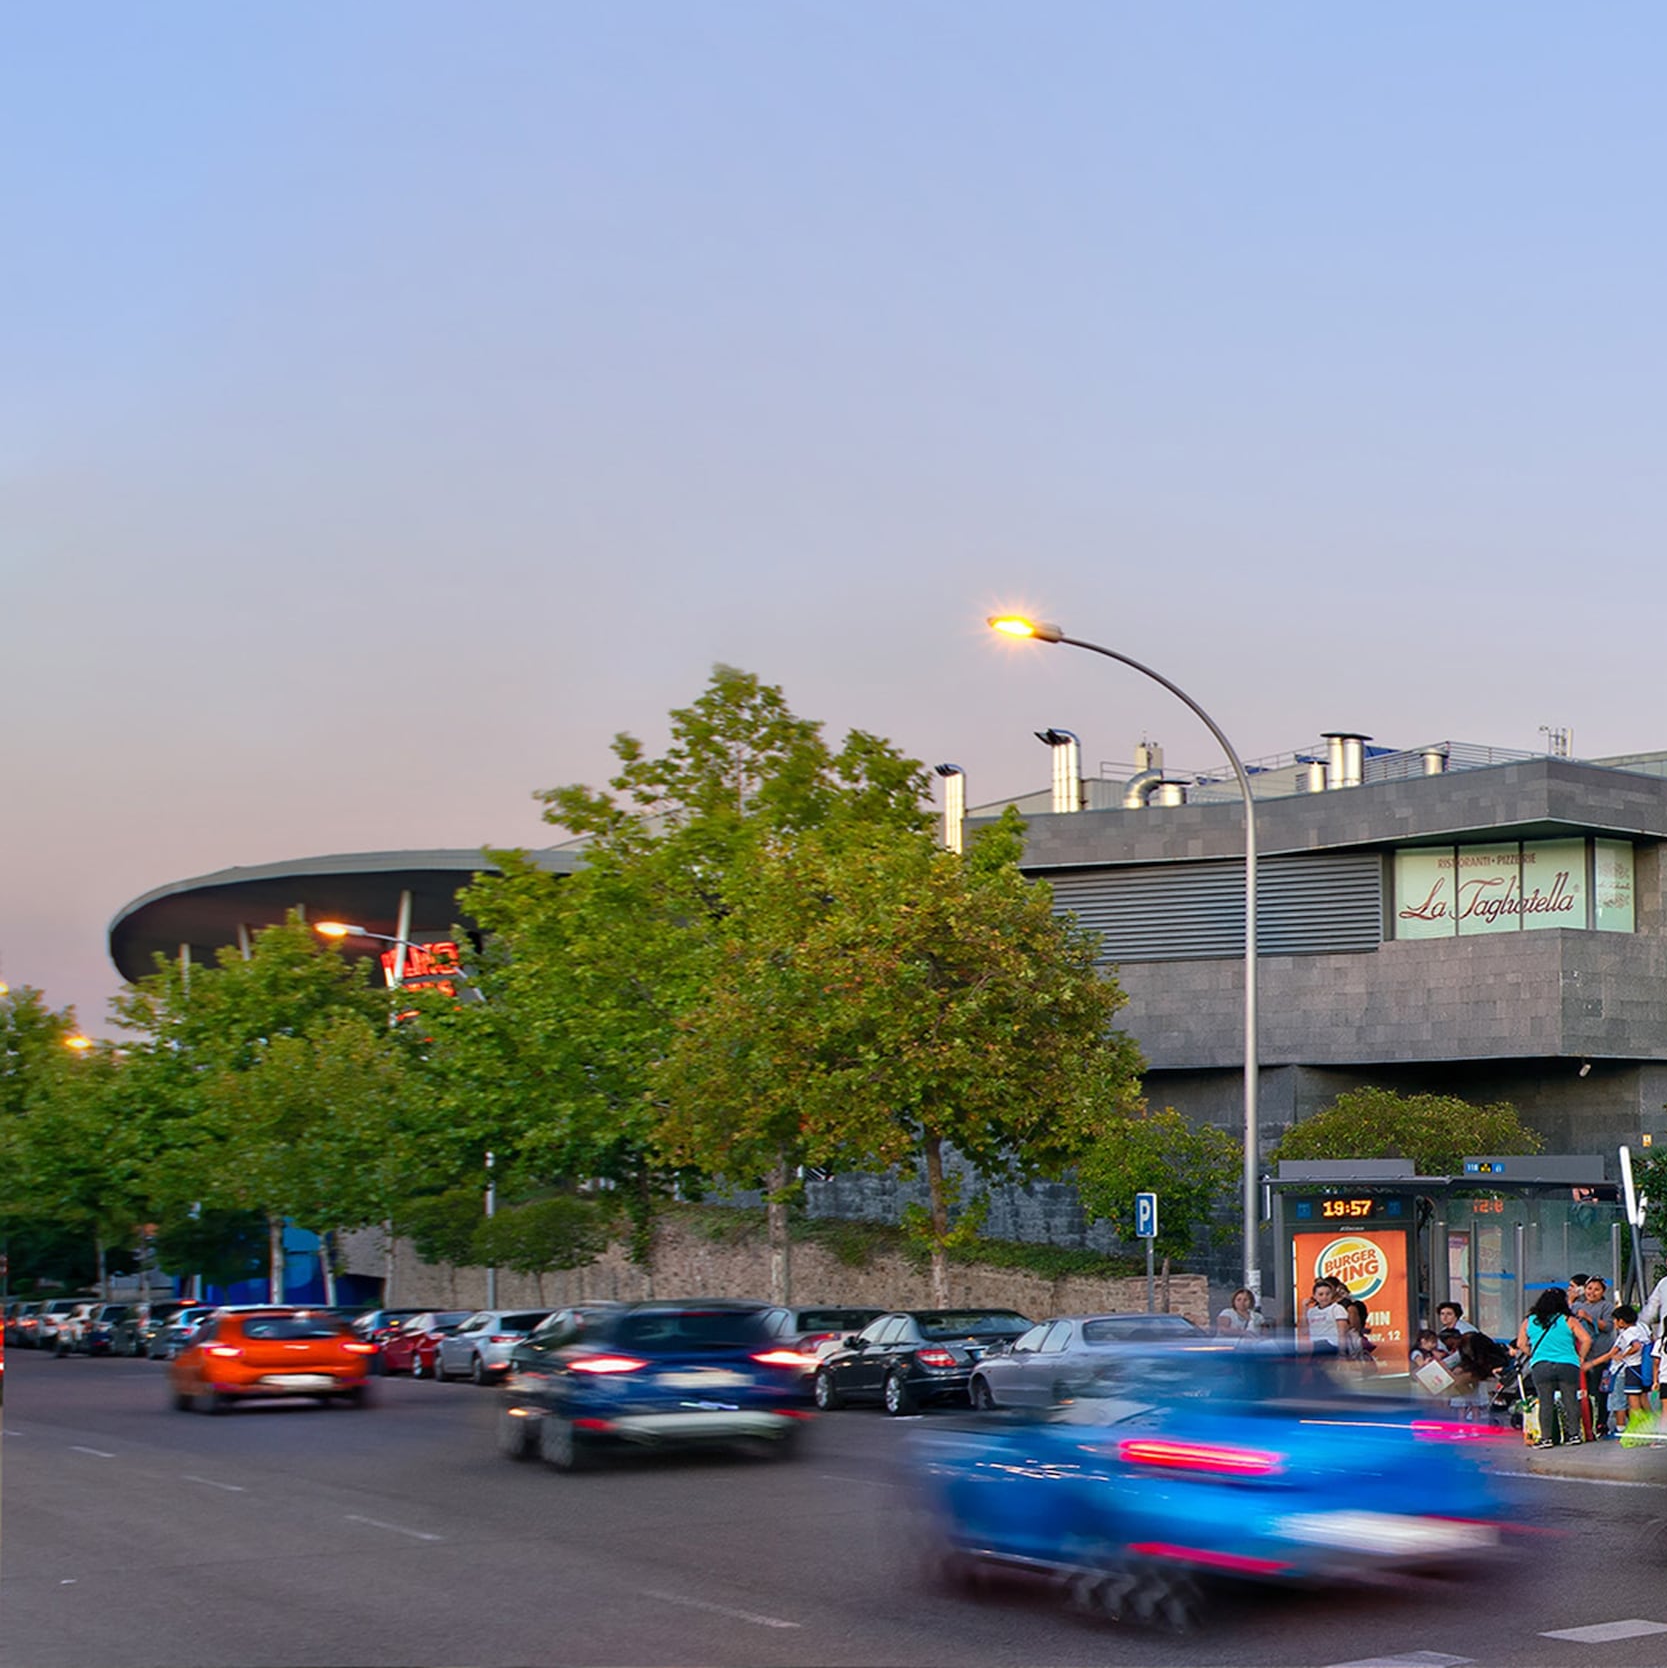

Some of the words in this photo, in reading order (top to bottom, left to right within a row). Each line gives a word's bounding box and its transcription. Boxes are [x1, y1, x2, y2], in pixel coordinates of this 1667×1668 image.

[1399, 877, 1446, 920] La
[1139, 1199, 1151, 1232] P
[1323, 1200, 1372, 1217] 19:57
[1324, 1248, 1377, 1274] BURGER
